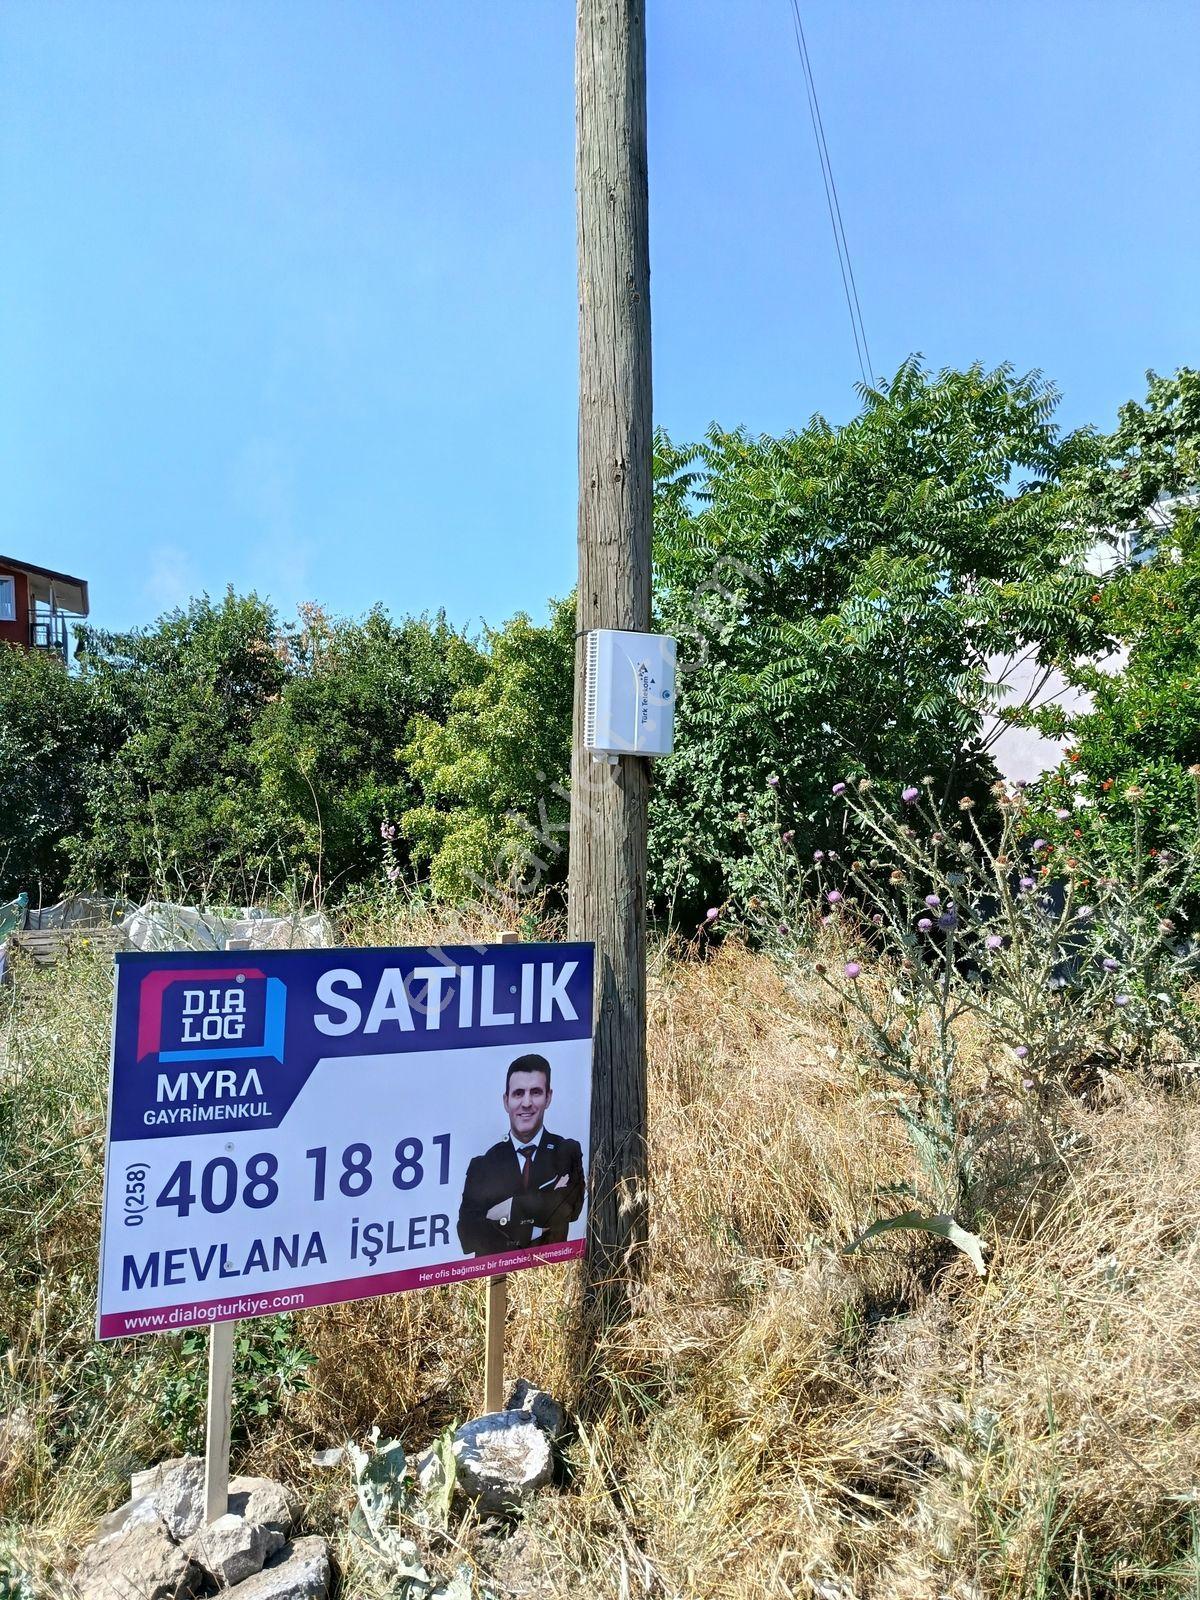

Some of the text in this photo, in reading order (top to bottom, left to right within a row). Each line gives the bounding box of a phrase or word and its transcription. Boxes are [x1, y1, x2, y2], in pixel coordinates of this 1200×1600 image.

[641, 676, 649, 706] Telekom
[182, 988, 247, 1015] DIA
[313, 961, 580, 1037] SATILIK
[180, 1014, 246, 1042] LOG
[156, 1068, 264, 1103] MYRA
[143, 1101, 273, 1126] GAYRİMENKUL
[123, 1132, 451, 1227] 0(258) 408 18 81
[121, 1213, 450, 1292] MEVLANA İŞLER
[418, 1272, 434, 1282] Her
[435, 1268, 450, 1279] ofis
[451, 1263, 487, 1276] bağımsız
[487, 1260, 498, 1270] bir
[124, 1292, 305, 1330] www.dialogturkiye.com
